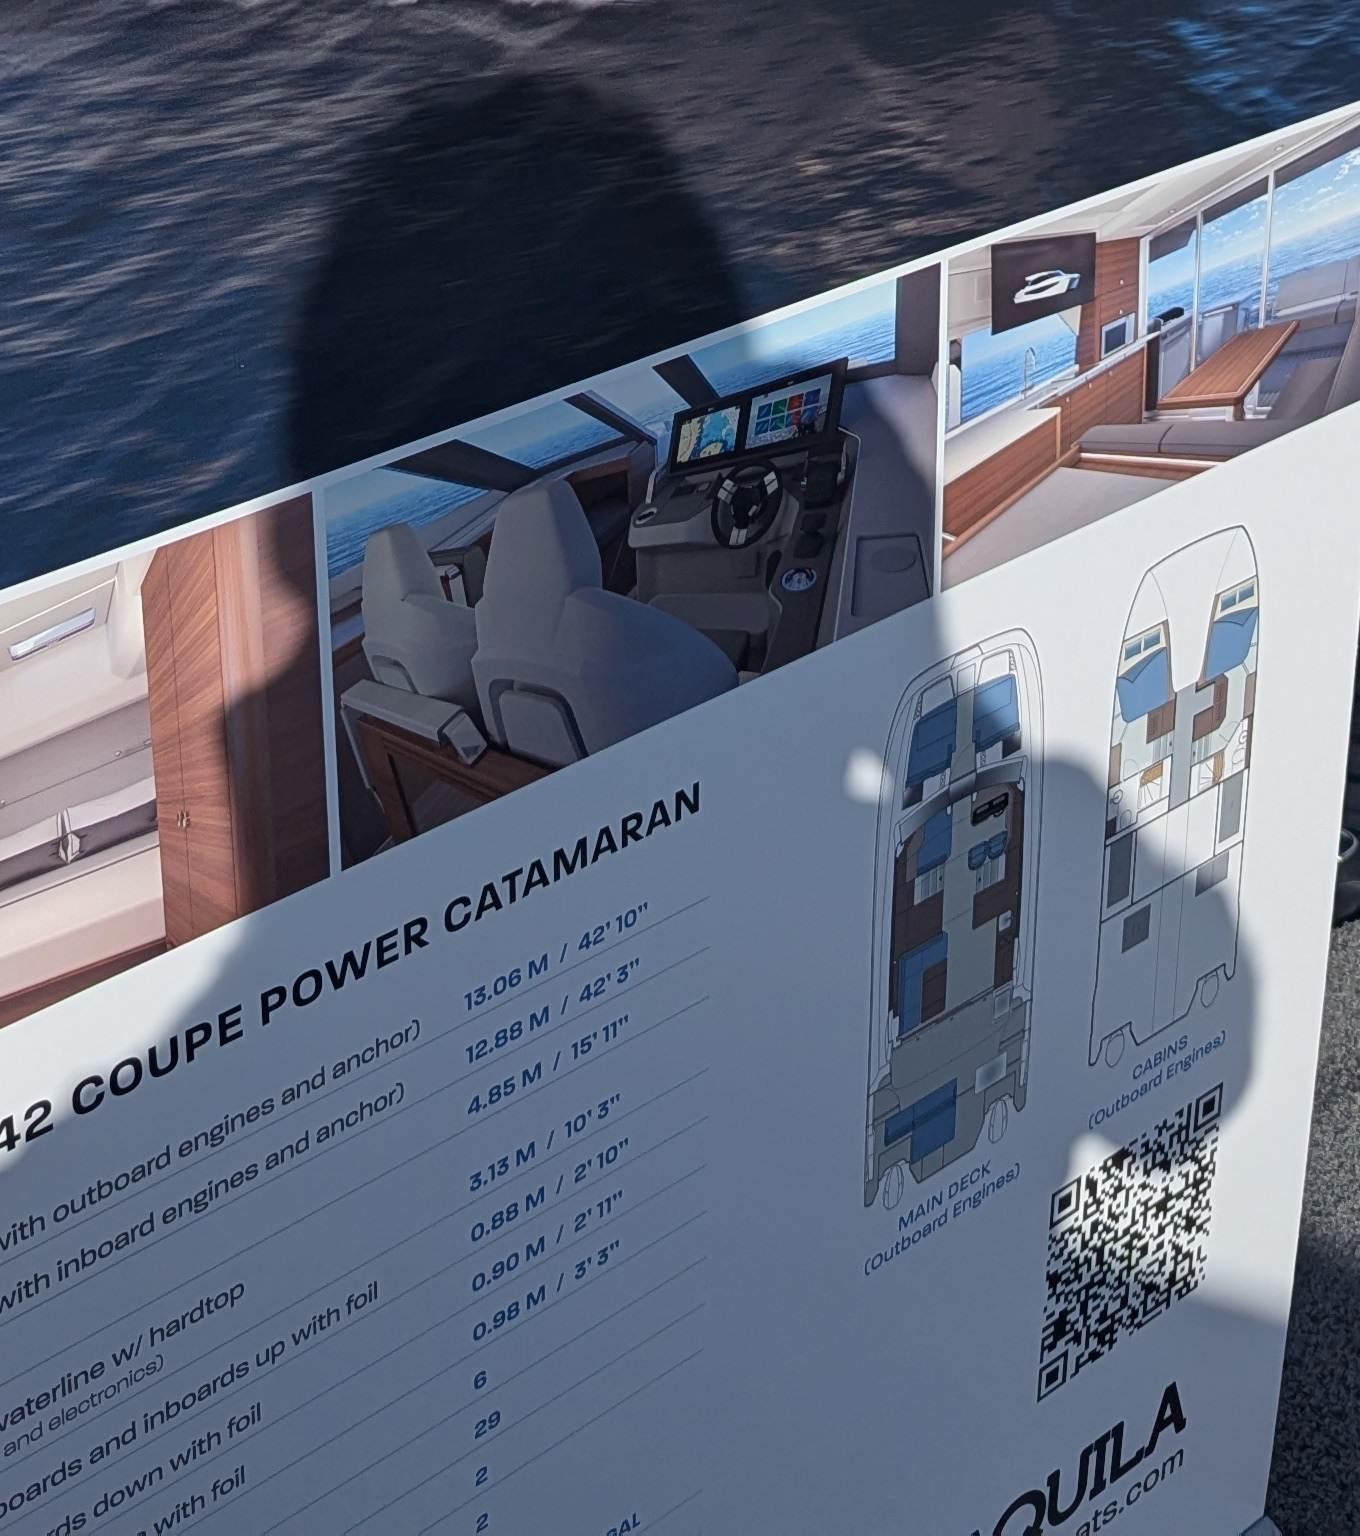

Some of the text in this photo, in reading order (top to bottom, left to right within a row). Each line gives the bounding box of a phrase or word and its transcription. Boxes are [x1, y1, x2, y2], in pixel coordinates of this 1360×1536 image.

[72, 1004, 244, 1115] COUPE
[260, 917, 429, 1026] POWER
[444, 781, 701, 932] CATAMARAN
[464, 968, 522, 1011] 13.06
[528, 953, 549, 979] M
[466, 1021, 523, 1064] 12.88
[529, 1006, 550, 1031] M
[1132, 1035, 1188, 1080] CABINS
[467, 1077, 516, 1115] 4.85
[521, 1062, 542, 1088] M
[1089, 1030, 1226, 1130] (Outboard Engines)
[53, 1145, 171, 1223] outboard
[178, 1096, 275, 1158] engines
[281, 1067, 326, 1106] and
[332, 1019, 420, 1080] anchor)
[57, 1212, 156, 1283] inboard
[162, 1162, 259, 1224] engines
[265, 1131, 311, 1170] and
[316, 1082, 405, 1143] anchor)
[469, 1157, 510, 1192] 3.13
[515, 1141, 536, 1167] M
[899, 1160, 992, 1231] MAIN DECK
[471, 1202, 519, 1243] 0.88
[525, 1186, 545, 1212] M
[865, 1162, 1020, 1276] (Outboard Engines)
[472, 1253, 519, 1293] 0.90
[525, 1236, 546, 1262] M
[112, 1335, 143, 1367] w/
[150, 1282, 245, 1347] hardtop
[472, 1302, 520, 1342] 0.98
[525, 1285, 546, 1310] M
[89, 1420, 136, 1465] and
[143, 1361, 249, 1434] inboards
[255, 1339, 285, 1368] up
[291, 1306, 341, 1347] with
[345, 1280, 379, 1315] foil
[473, 1371, 487, 1390] 6
[3, 1422, 43, 1459] and
[48, 1353, 165, 1431] electronics)
[474, 1410, 501, 1440] 29
[93, 1402, 262, 1519] down with foil
[475, 1466, 488, 1487] 2
[970, 1381, 1187, 1536] QUILA
[153, 1465, 246, 1536] with foil
[475, 1513, 488, 1534] 2
